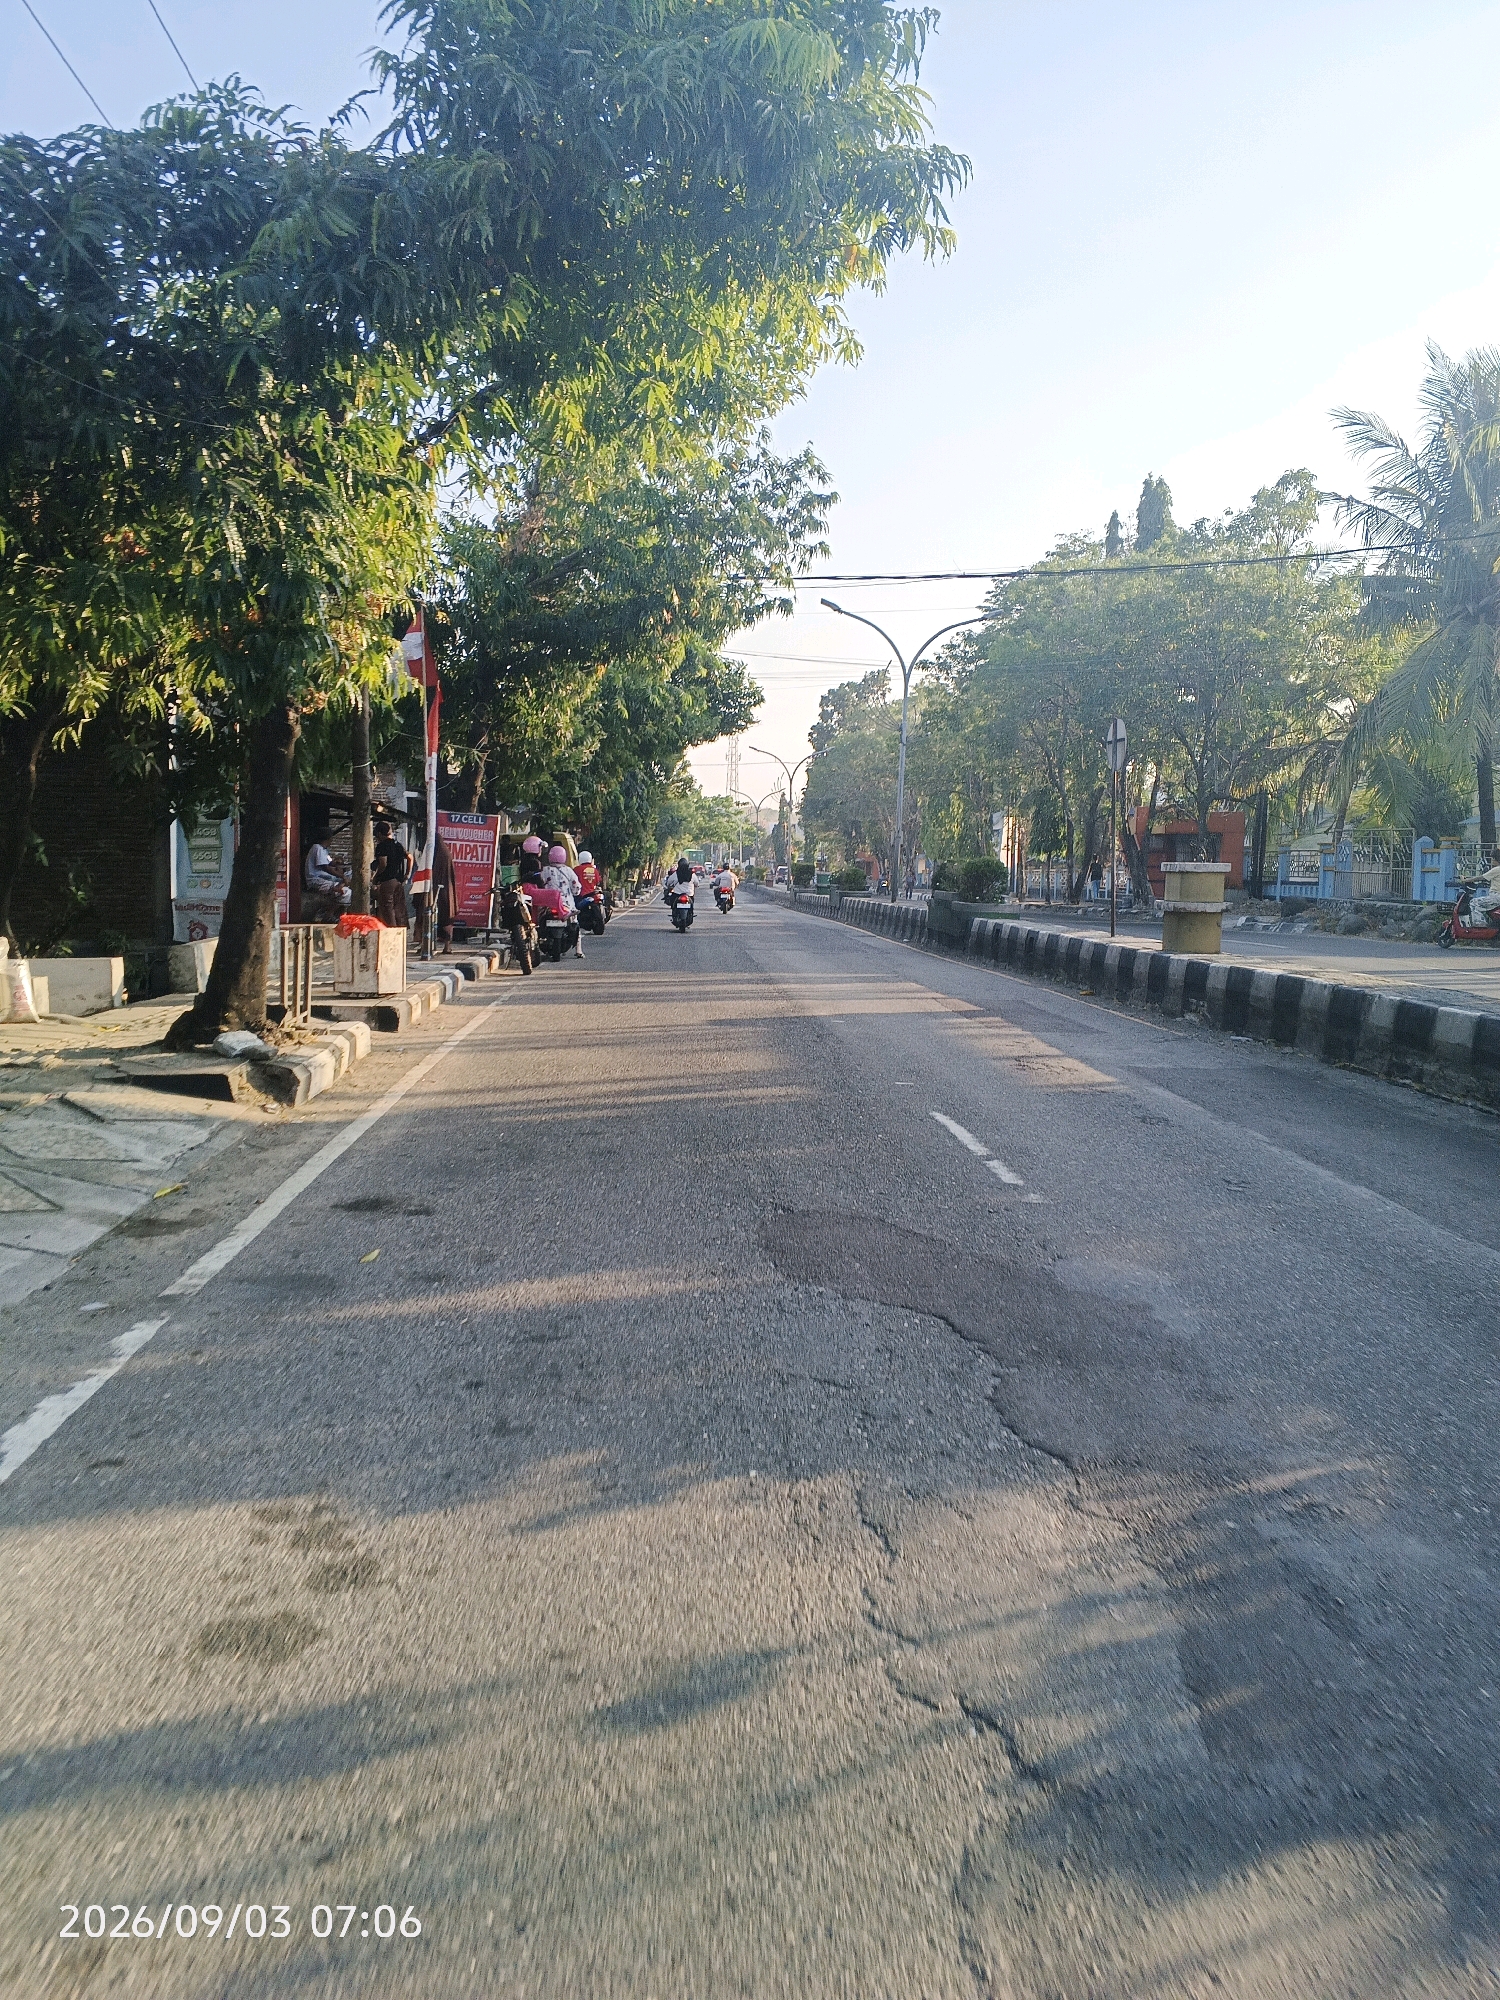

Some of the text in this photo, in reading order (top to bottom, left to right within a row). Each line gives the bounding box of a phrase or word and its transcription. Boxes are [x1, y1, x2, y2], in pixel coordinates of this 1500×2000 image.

[450, 814, 484, 824] 17 CELL
[457, 828, 494, 841] VOUCHER
